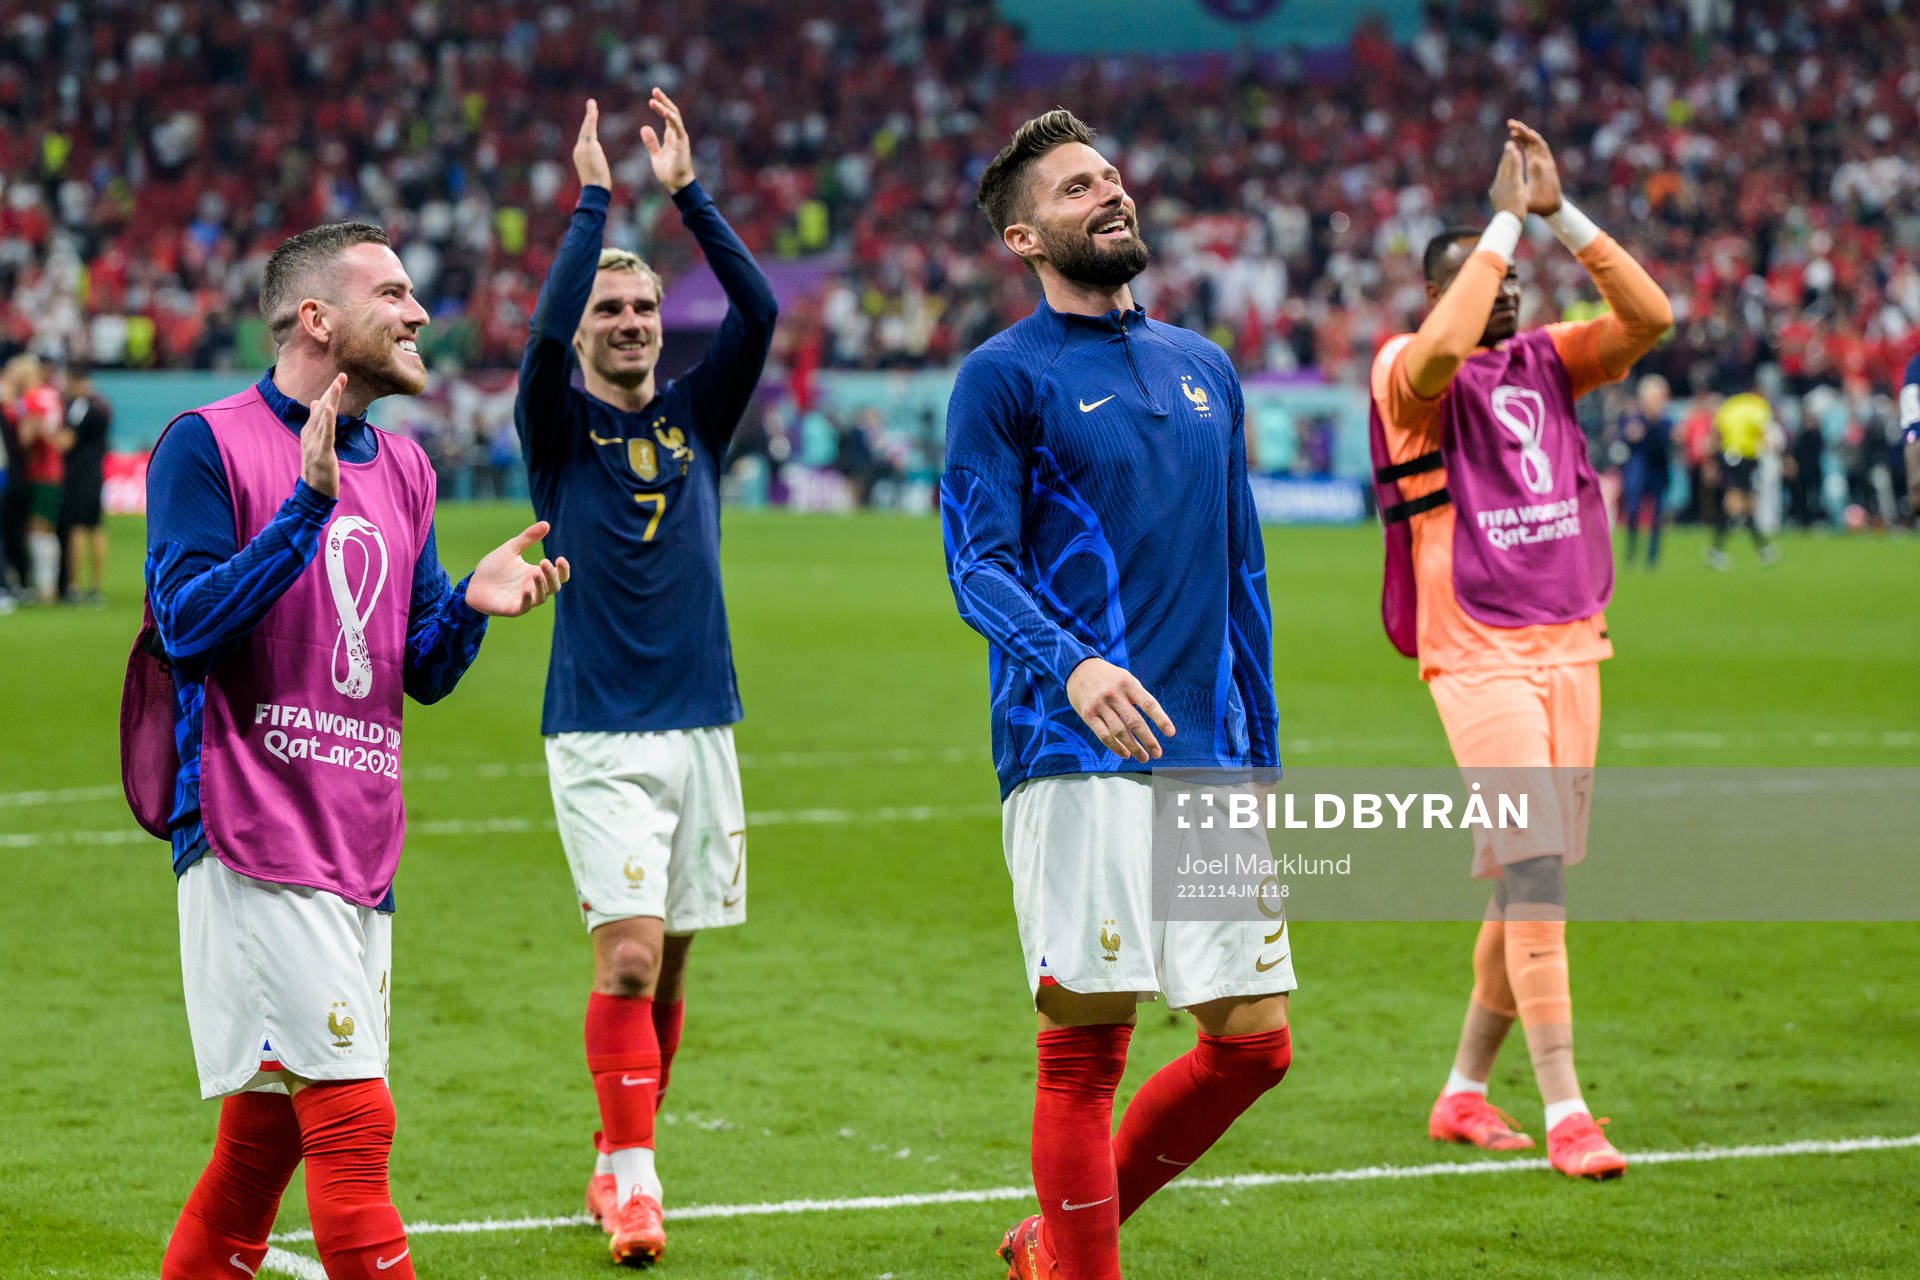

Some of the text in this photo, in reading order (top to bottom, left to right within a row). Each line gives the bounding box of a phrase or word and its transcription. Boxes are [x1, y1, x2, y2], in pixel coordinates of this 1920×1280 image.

[633, 493, 666, 542] 7
[255, 703, 313, 730] FIFA
[315, 710, 384, 744] WORLD
[729, 830, 745, 886] 7
[1257, 875, 1285, 945] 9
